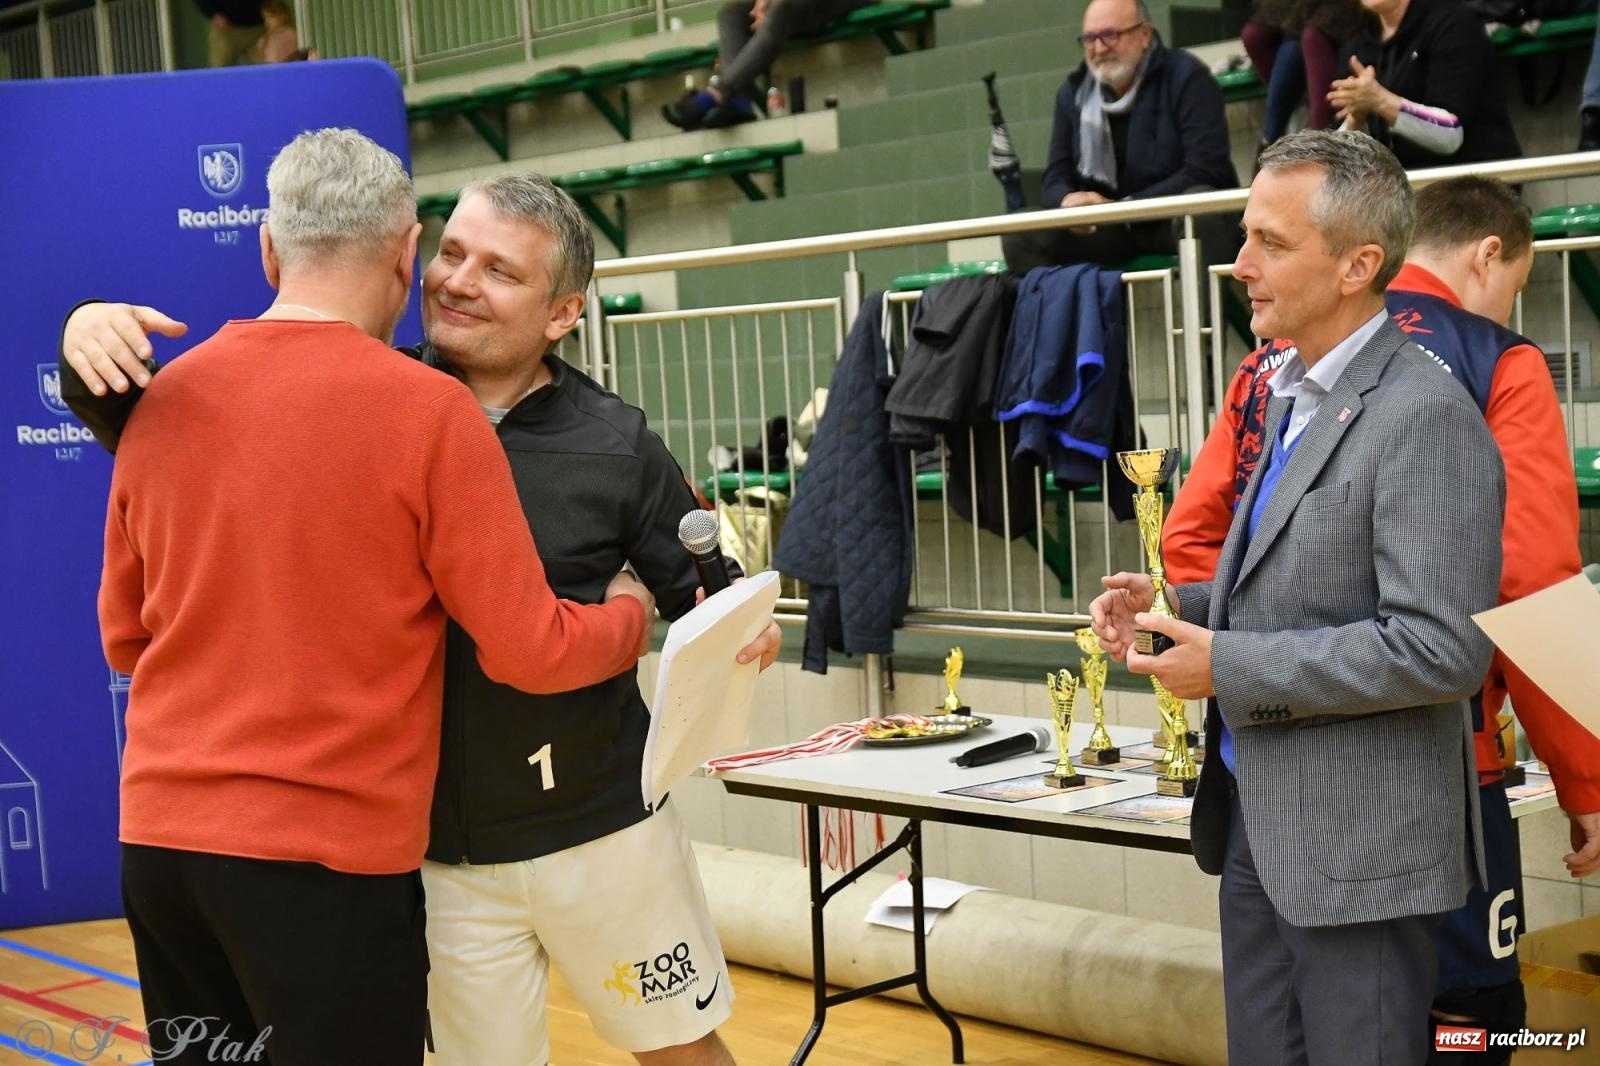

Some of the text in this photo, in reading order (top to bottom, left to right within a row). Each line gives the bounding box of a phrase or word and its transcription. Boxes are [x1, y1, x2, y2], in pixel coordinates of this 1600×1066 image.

[214, 231, 239, 245] 1217
[527, 743, 555, 791] 1
[633, 942, 690, 980] ZOO
[641, 960, 697, 998] MAR
[644, 975, 700, 1005] sklep zoologiczny
